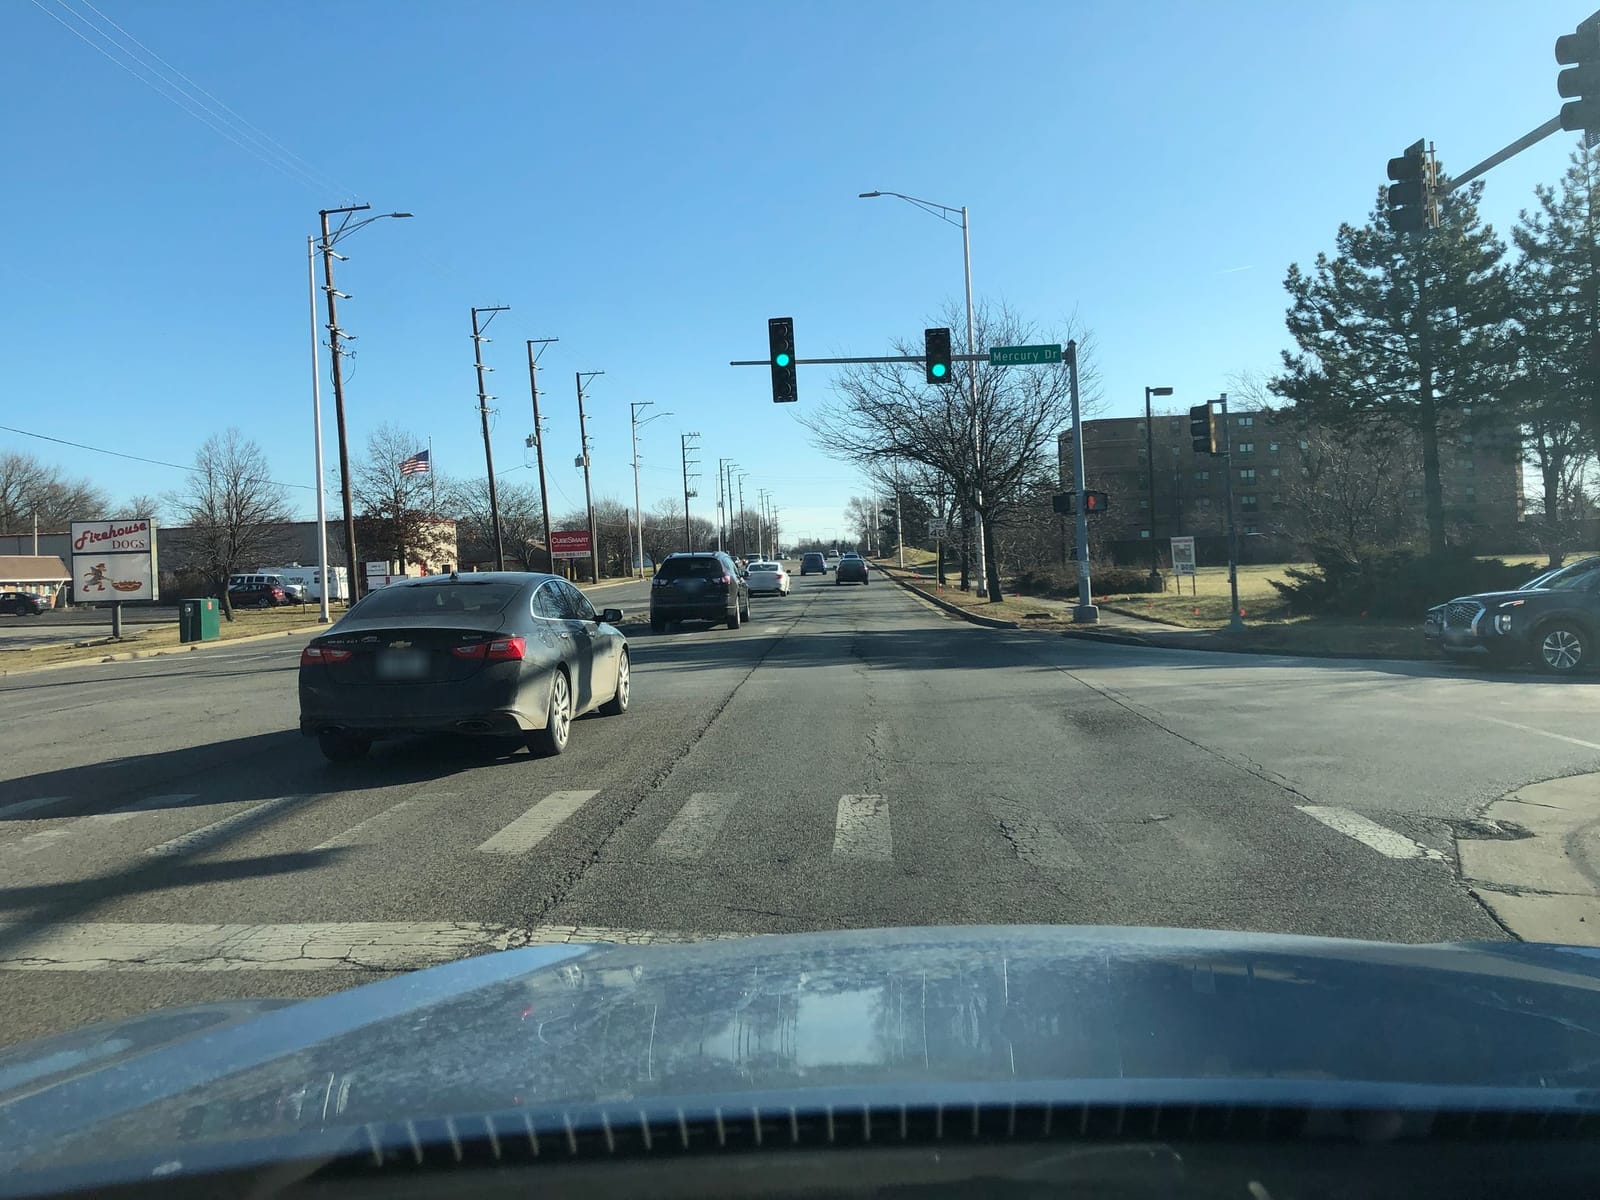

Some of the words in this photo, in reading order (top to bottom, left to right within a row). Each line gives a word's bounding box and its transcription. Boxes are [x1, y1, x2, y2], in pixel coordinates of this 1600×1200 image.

[993, 351, 1039, 362] Mercury
[1044, 349, 1058, 359] Dr
[74, 522, 148, 550] Firehouse
[112, 539, 145, 549] DOGS
